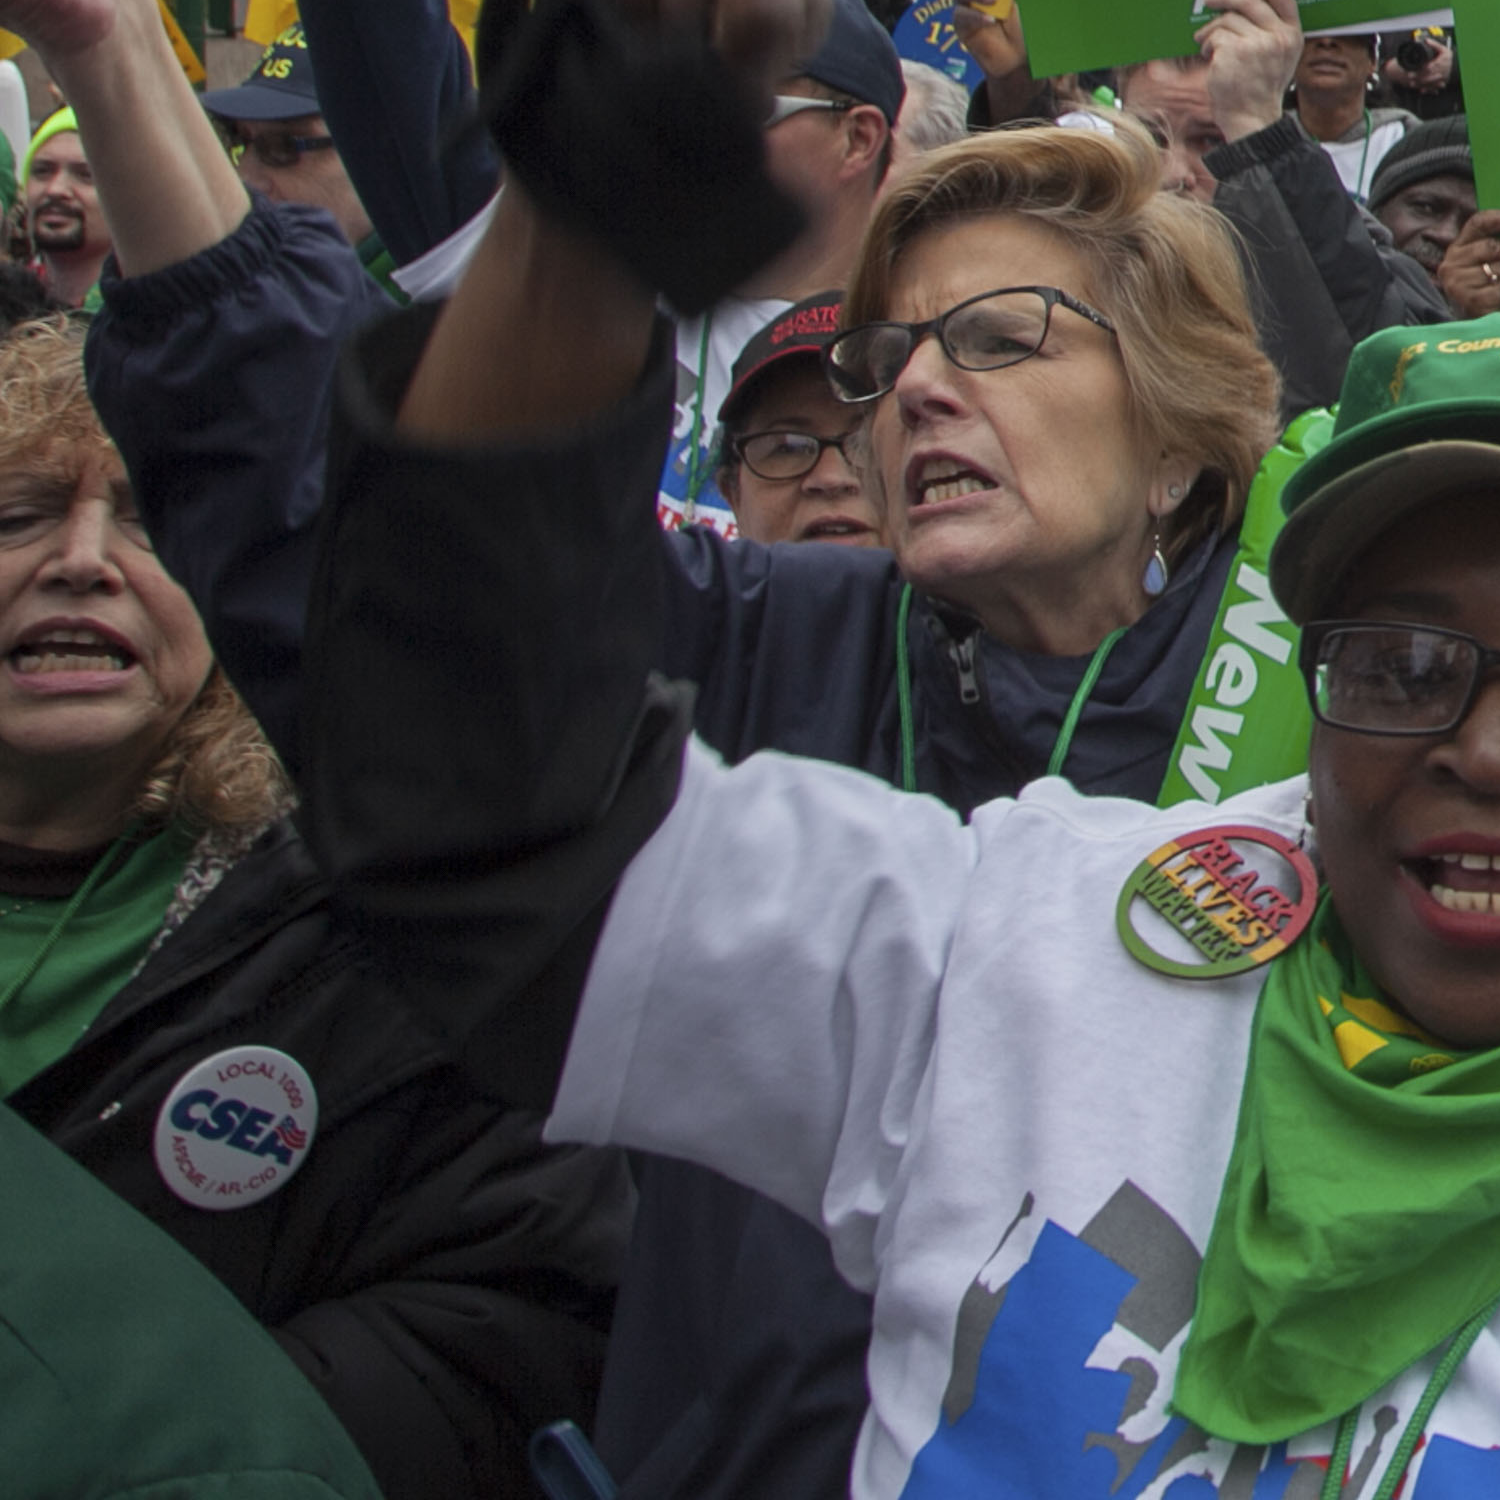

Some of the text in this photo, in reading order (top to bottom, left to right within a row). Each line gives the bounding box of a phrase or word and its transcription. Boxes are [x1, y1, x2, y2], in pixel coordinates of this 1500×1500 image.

[1157, 855, 1273, 946] LIVES
[217, 1060, 275, 1083] LOCAL
[170, 1089, 303, 1167] CSEA
